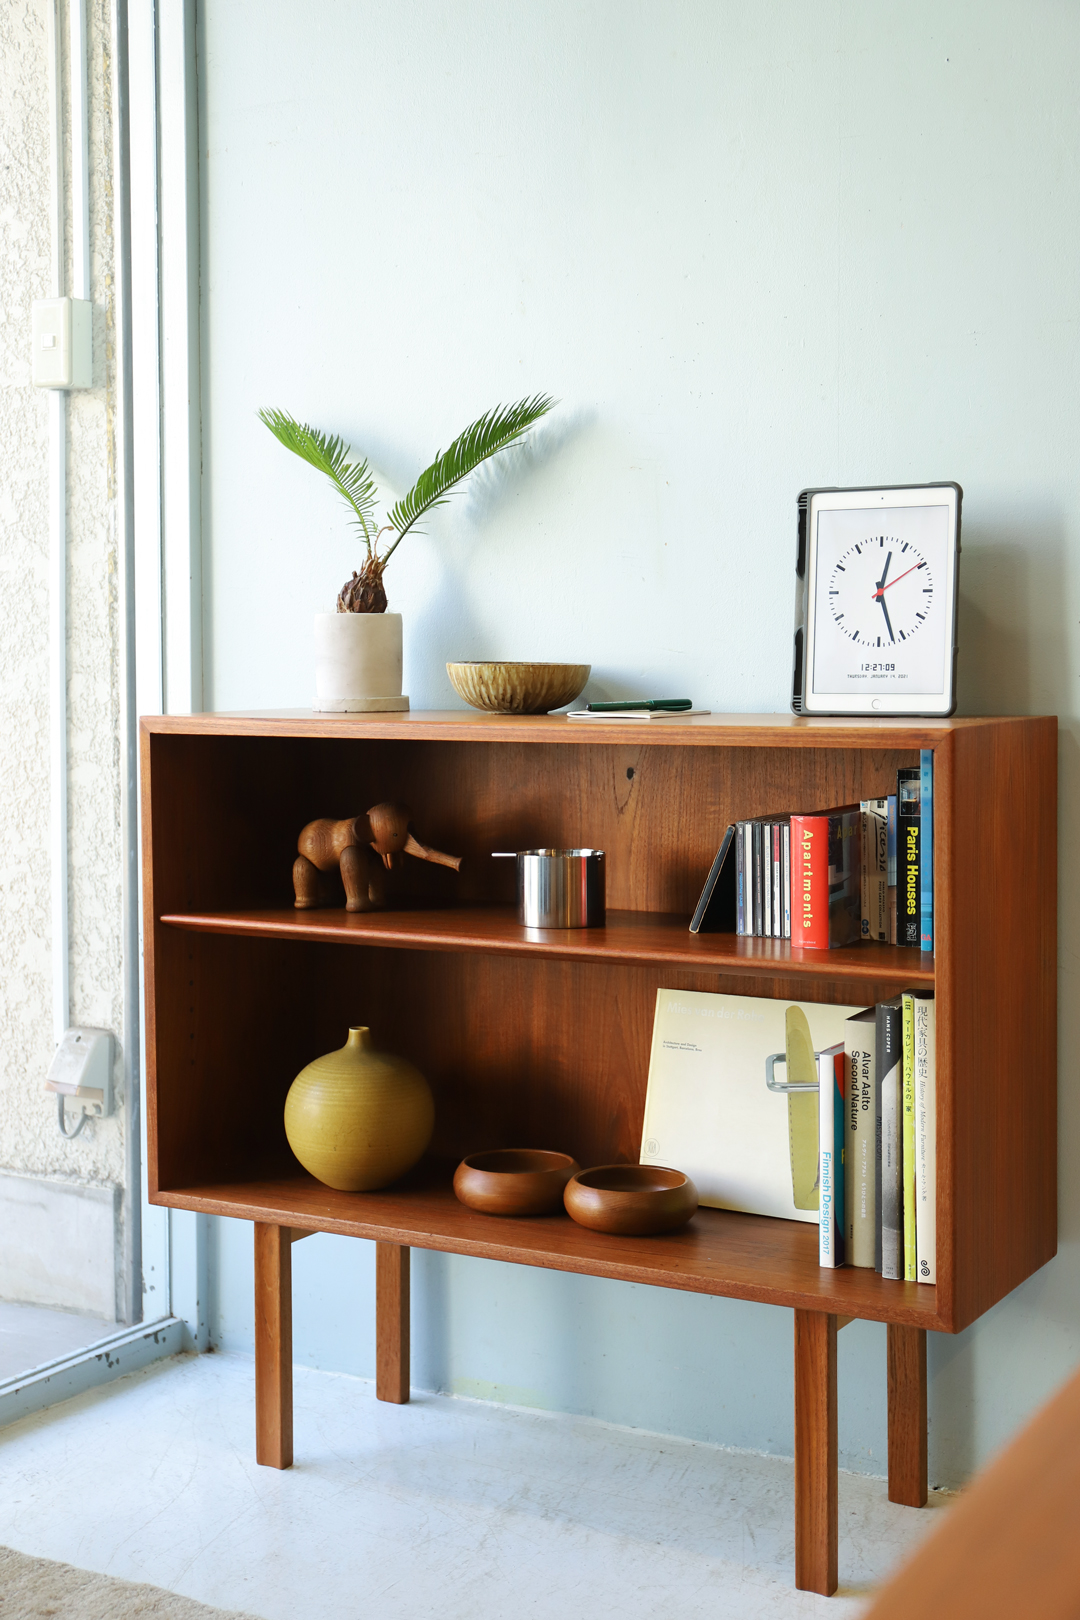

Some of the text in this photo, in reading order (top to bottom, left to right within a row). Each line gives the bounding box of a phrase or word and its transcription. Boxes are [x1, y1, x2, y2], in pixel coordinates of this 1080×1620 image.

[861, 664, 896, 672] 12:27:09
[870, 810, 888, 872] Picasso
[906, 826, 919, 861] Paris
[801, 830, 814, 928] Apartments
[906, 865, 919, 915] Houses
[917, 1006, 928, 1078] 現代家具の歴史
[850, 1050, 860, 1131] Second Nature
[861, 1051, 871, 1111] Alvar Aalto
[822, 1152, 831, 1192] Finnish
[821, 1195, 831, 1233] Design
